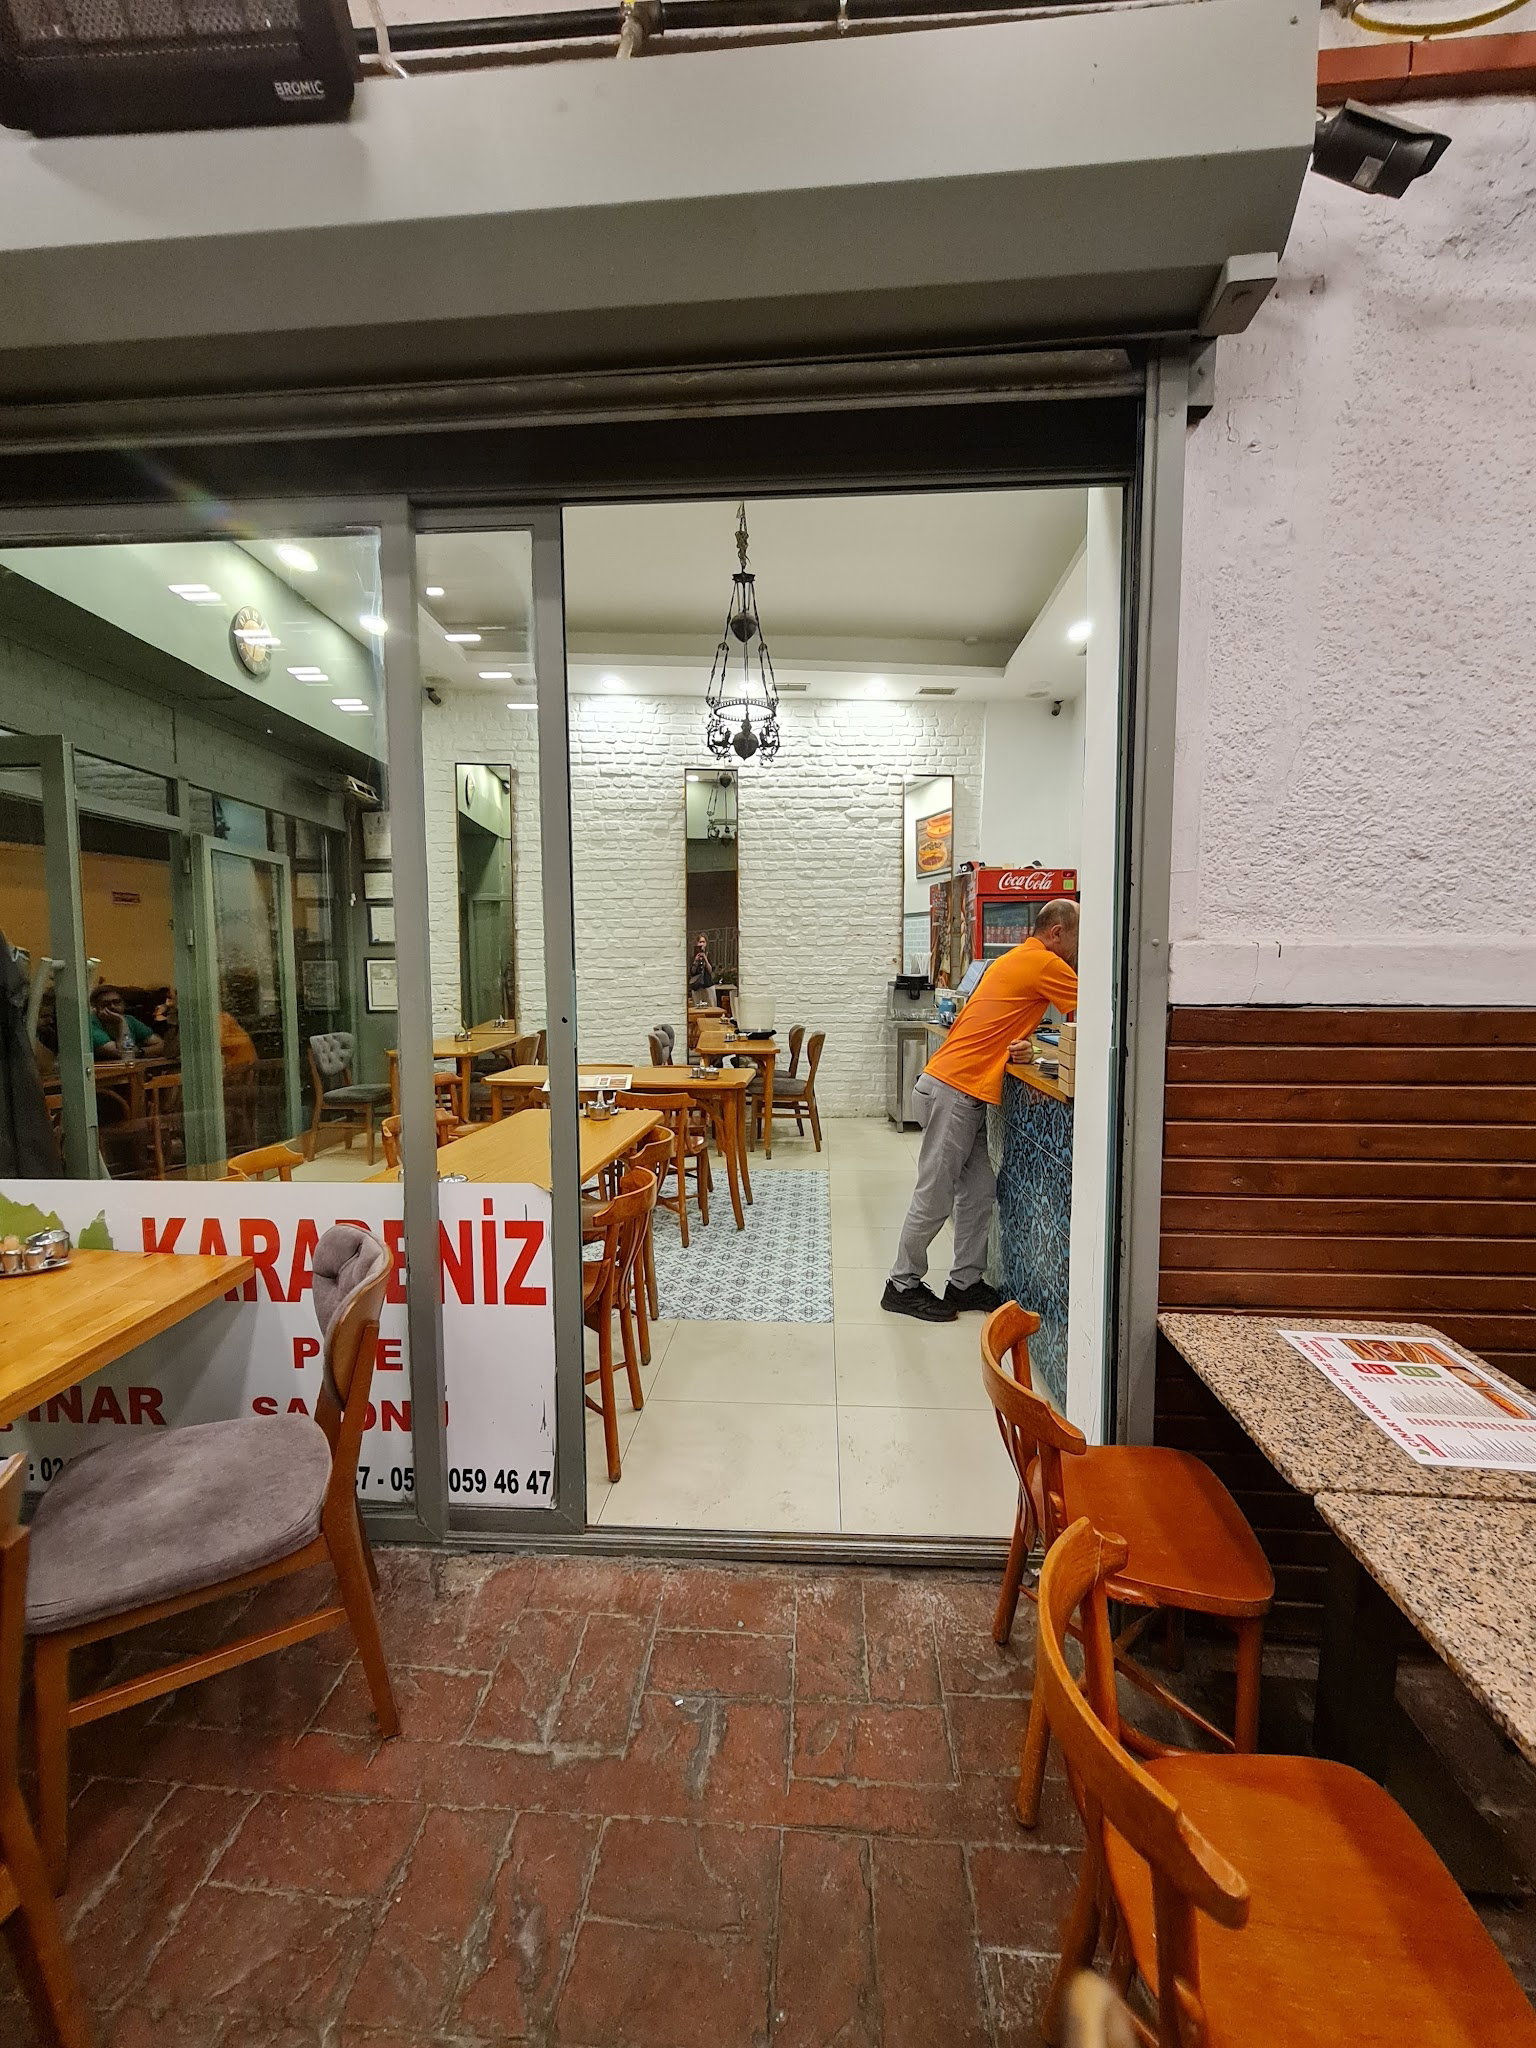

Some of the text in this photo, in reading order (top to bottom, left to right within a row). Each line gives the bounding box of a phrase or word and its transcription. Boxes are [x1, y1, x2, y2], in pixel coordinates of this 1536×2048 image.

[274, 80, 324, 95] BROMIC
[998, 871, 1055, 891] Coca-Cola
[293, 1337, 403, 1371] PE
[356, 1466, 370, 1490] 7
[391, 1467, 414, 1492] 05
[449, 1468, 487, 1493] 059
[493, 1469, 519, 1494] 46
[526, 1470, 551, 1494] 47
